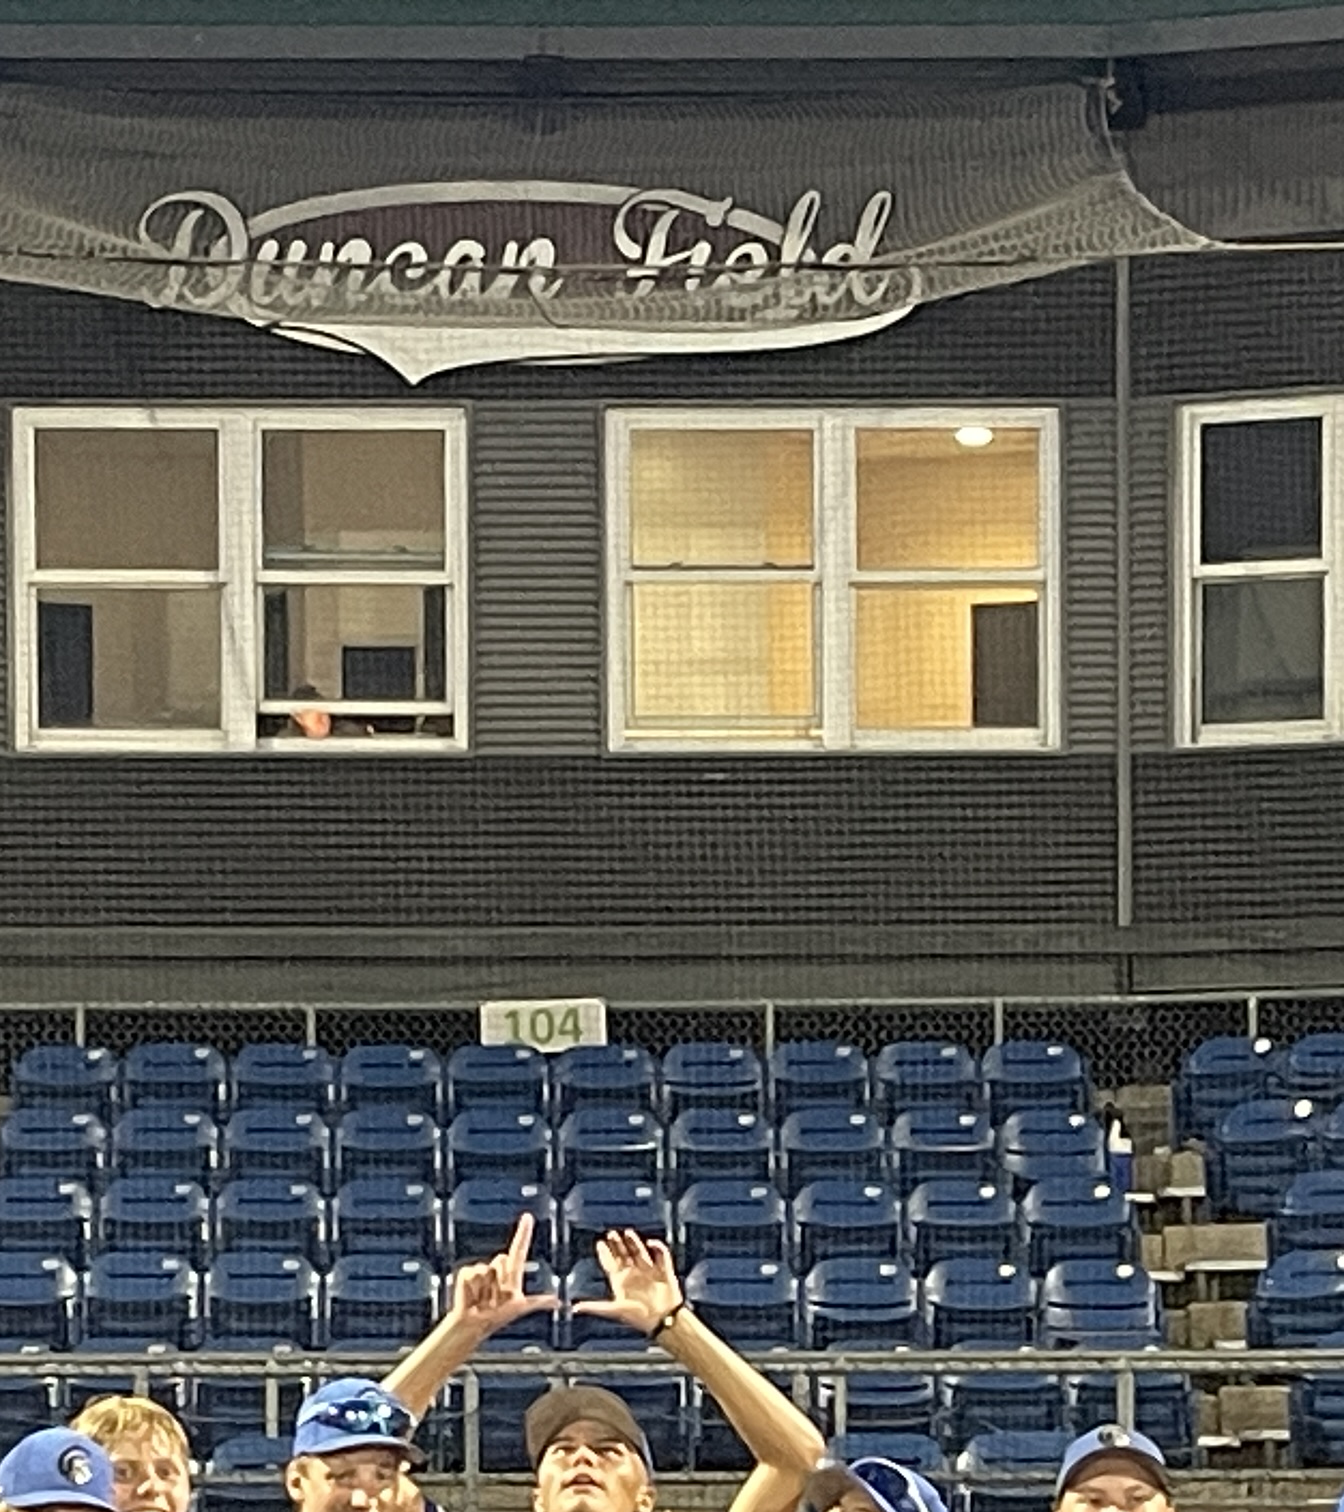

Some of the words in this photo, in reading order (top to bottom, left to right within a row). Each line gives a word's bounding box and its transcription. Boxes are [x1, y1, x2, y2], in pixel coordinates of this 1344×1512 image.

[138, 190, 564, 306] Duncan
[614, 188, 892, 304] Field
[504, 1007, 583, 1044] 104
